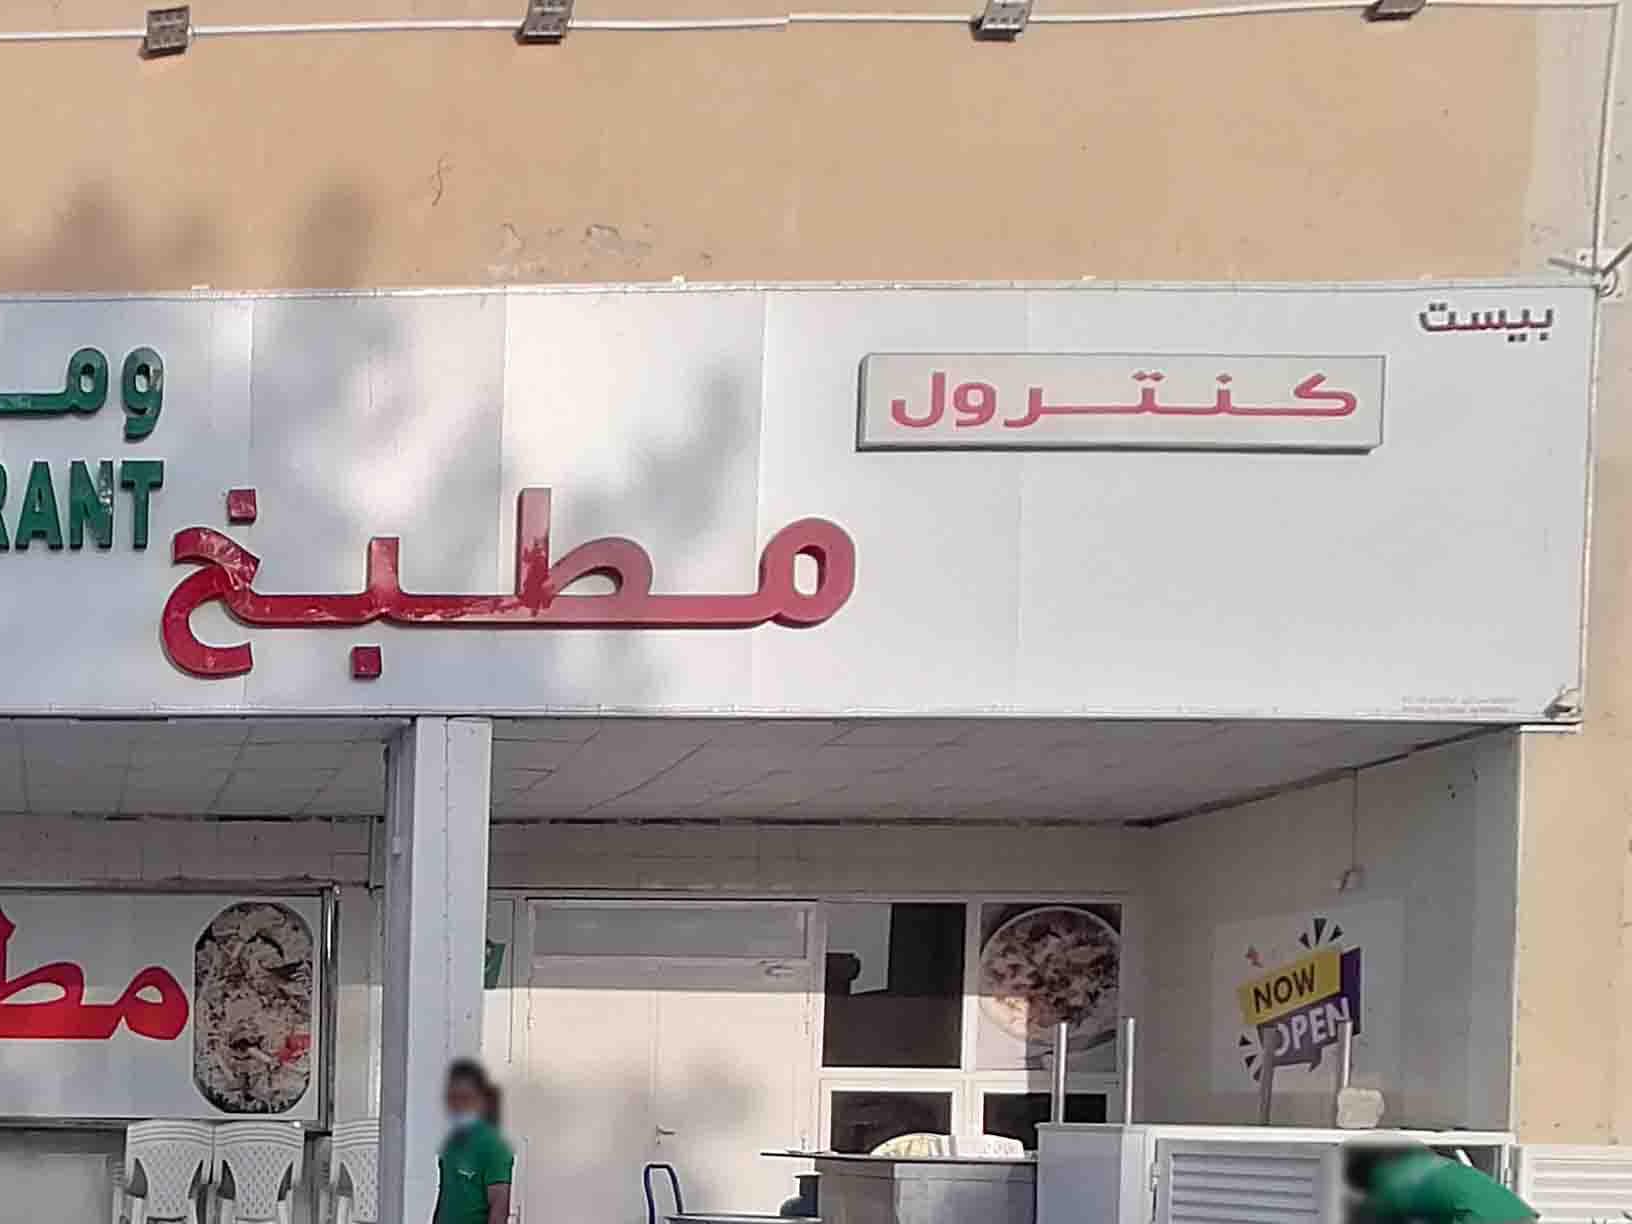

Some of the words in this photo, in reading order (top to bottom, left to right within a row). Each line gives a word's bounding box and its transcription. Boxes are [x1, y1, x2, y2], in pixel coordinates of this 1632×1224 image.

[1418, 299, 1553, 343] بيست
[890, 370, 1358, 428] كنترول
[161, 488, 857, 679] مطبخ
[1252, 962, 1316, 1014] NOW
